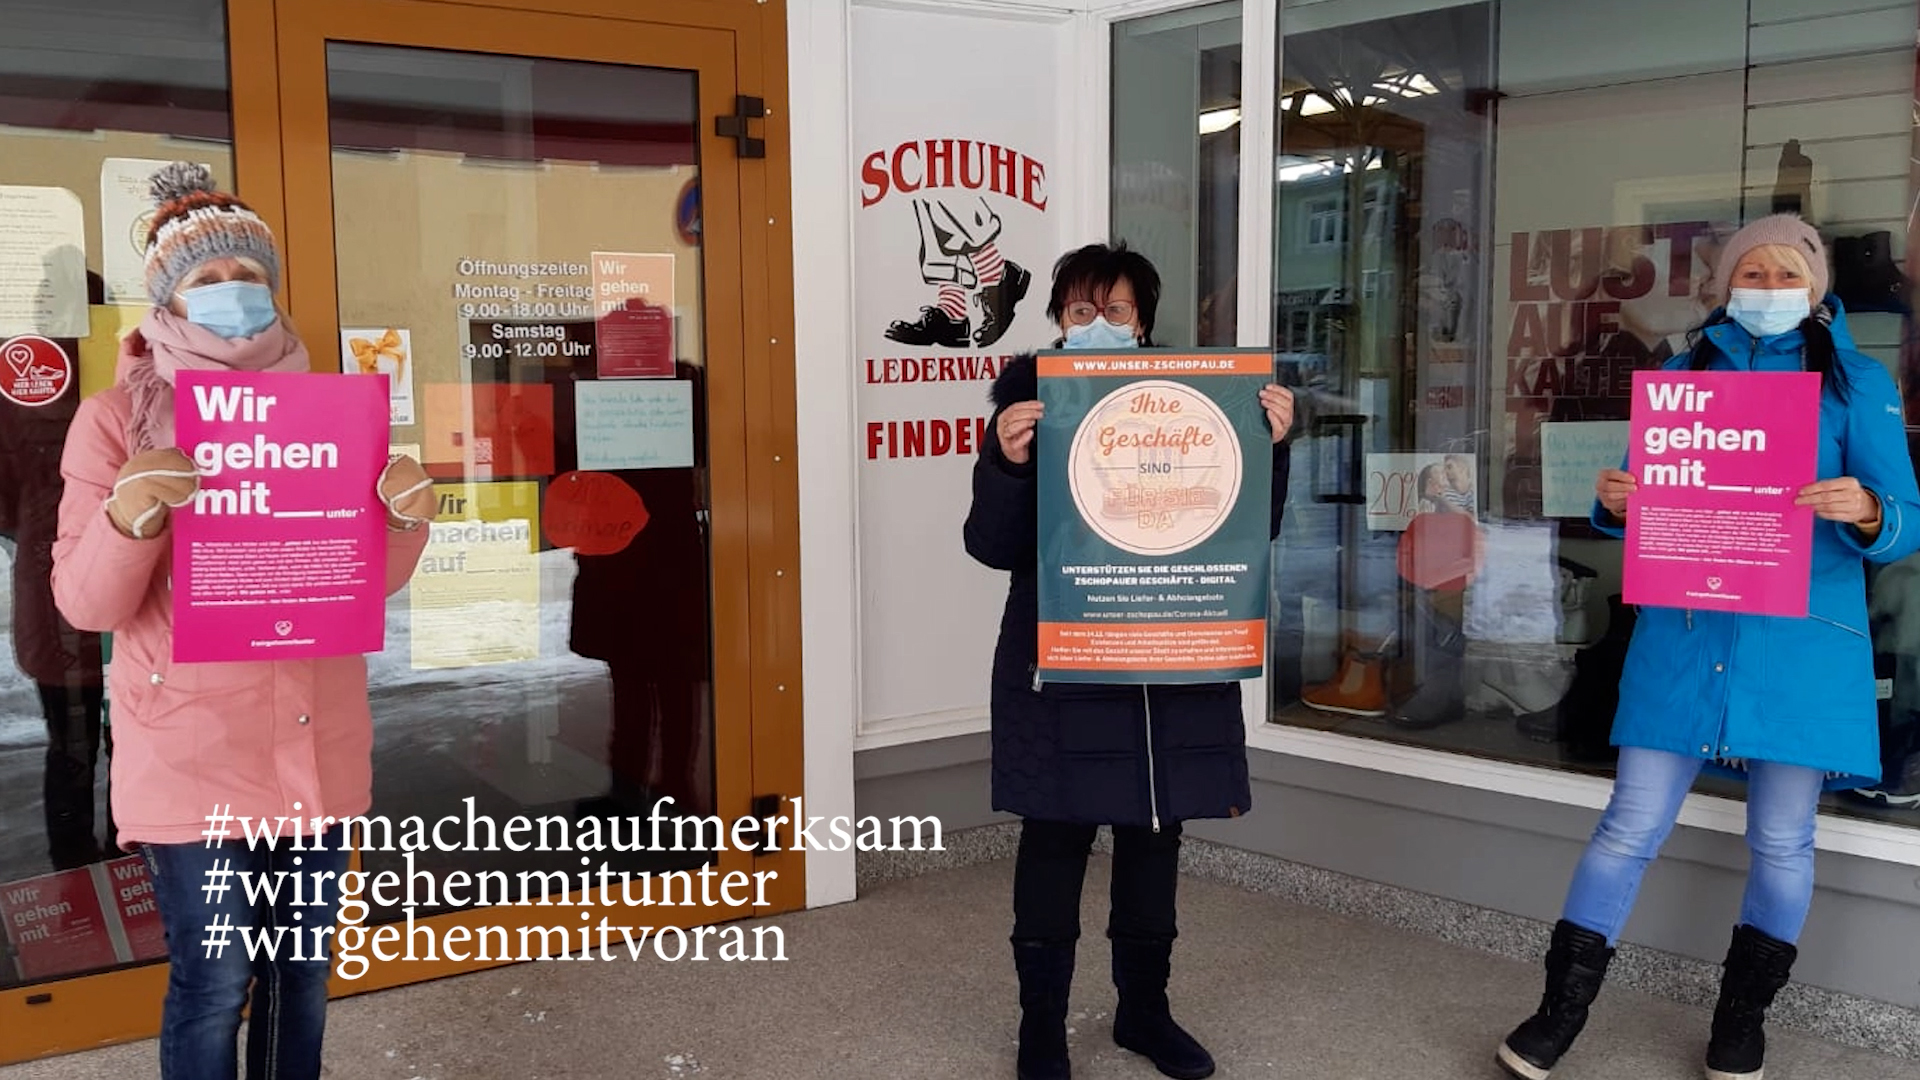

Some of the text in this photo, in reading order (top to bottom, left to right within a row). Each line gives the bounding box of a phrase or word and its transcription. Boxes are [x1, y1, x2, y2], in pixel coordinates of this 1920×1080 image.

[861, 139, 1048, 212] SCHUHE
[460, 256, 588, 279] Öffnungszeiten
[600, 260, 627, 275] Wir
[1509, 221, 1709, 302] LUST
[455, 283, 520, 301] Montag
[537, 283, 594, 300] Freitag
[600, 278, 649, 295] gehen
[463, 303, 501, 318] 9.00
[512, 303, 555, 317] 18.00
[560, 302, 590, 316] Uhr
[601, 298, 628, 312] mit
[492, 323, 566, 341] Samstag
[1507, 301, 1621, 357] AUF
[465, 343, 503, 358] 9.00
[514, 343, 557, 357] 12.00
[562, 342, 591, 356] Uhr
[1073, 359, 1235, 371] WWW.UNSER-ZSCHOPAU.DE
[1505, 356, 1635, 396] KALTE
[192, 385, 277, 422] Wir
[1130, 392, 1183, 414] Ihre
[1646, 383, 1713, 412] Wir
[1099, 426, 1215, 456] Geschäfte
[1644, 422, 1766, 455] gehen
[194, 434, 338, 477] gehen
[1139, 462, 1171, 474] SIND
[1643, 459, 1706, 487] mit
[1754, 486, 1783, 495] unter
[194, 480, 358, 519] mit unter
[1369, 469, 1417, 517] 20%
[438, 493, 467, 514] ir
[1138, 510, 1174, 530] DA
[421, 551, 467, 573] auf
[1062, 564, 1248, 575] UNTERSTÜTZEN SIE DIE GESCHLOSSENEN
[1074, 577, 1138, 586] ZSCHOPAUER
[1139, 575, 1194, 585] GESCHÄFTE
[1200, 576, 1237, 585] DIGITAL
[1087, 594, 1116, 603] Nutzen
[113, 864, 146, 881] Wir
[6, 887, 40, 905] Wir
[13, 901, 72, 927] gehen
[125, 898, 156, 917] mit
[19, 924, 50, 943] mit
